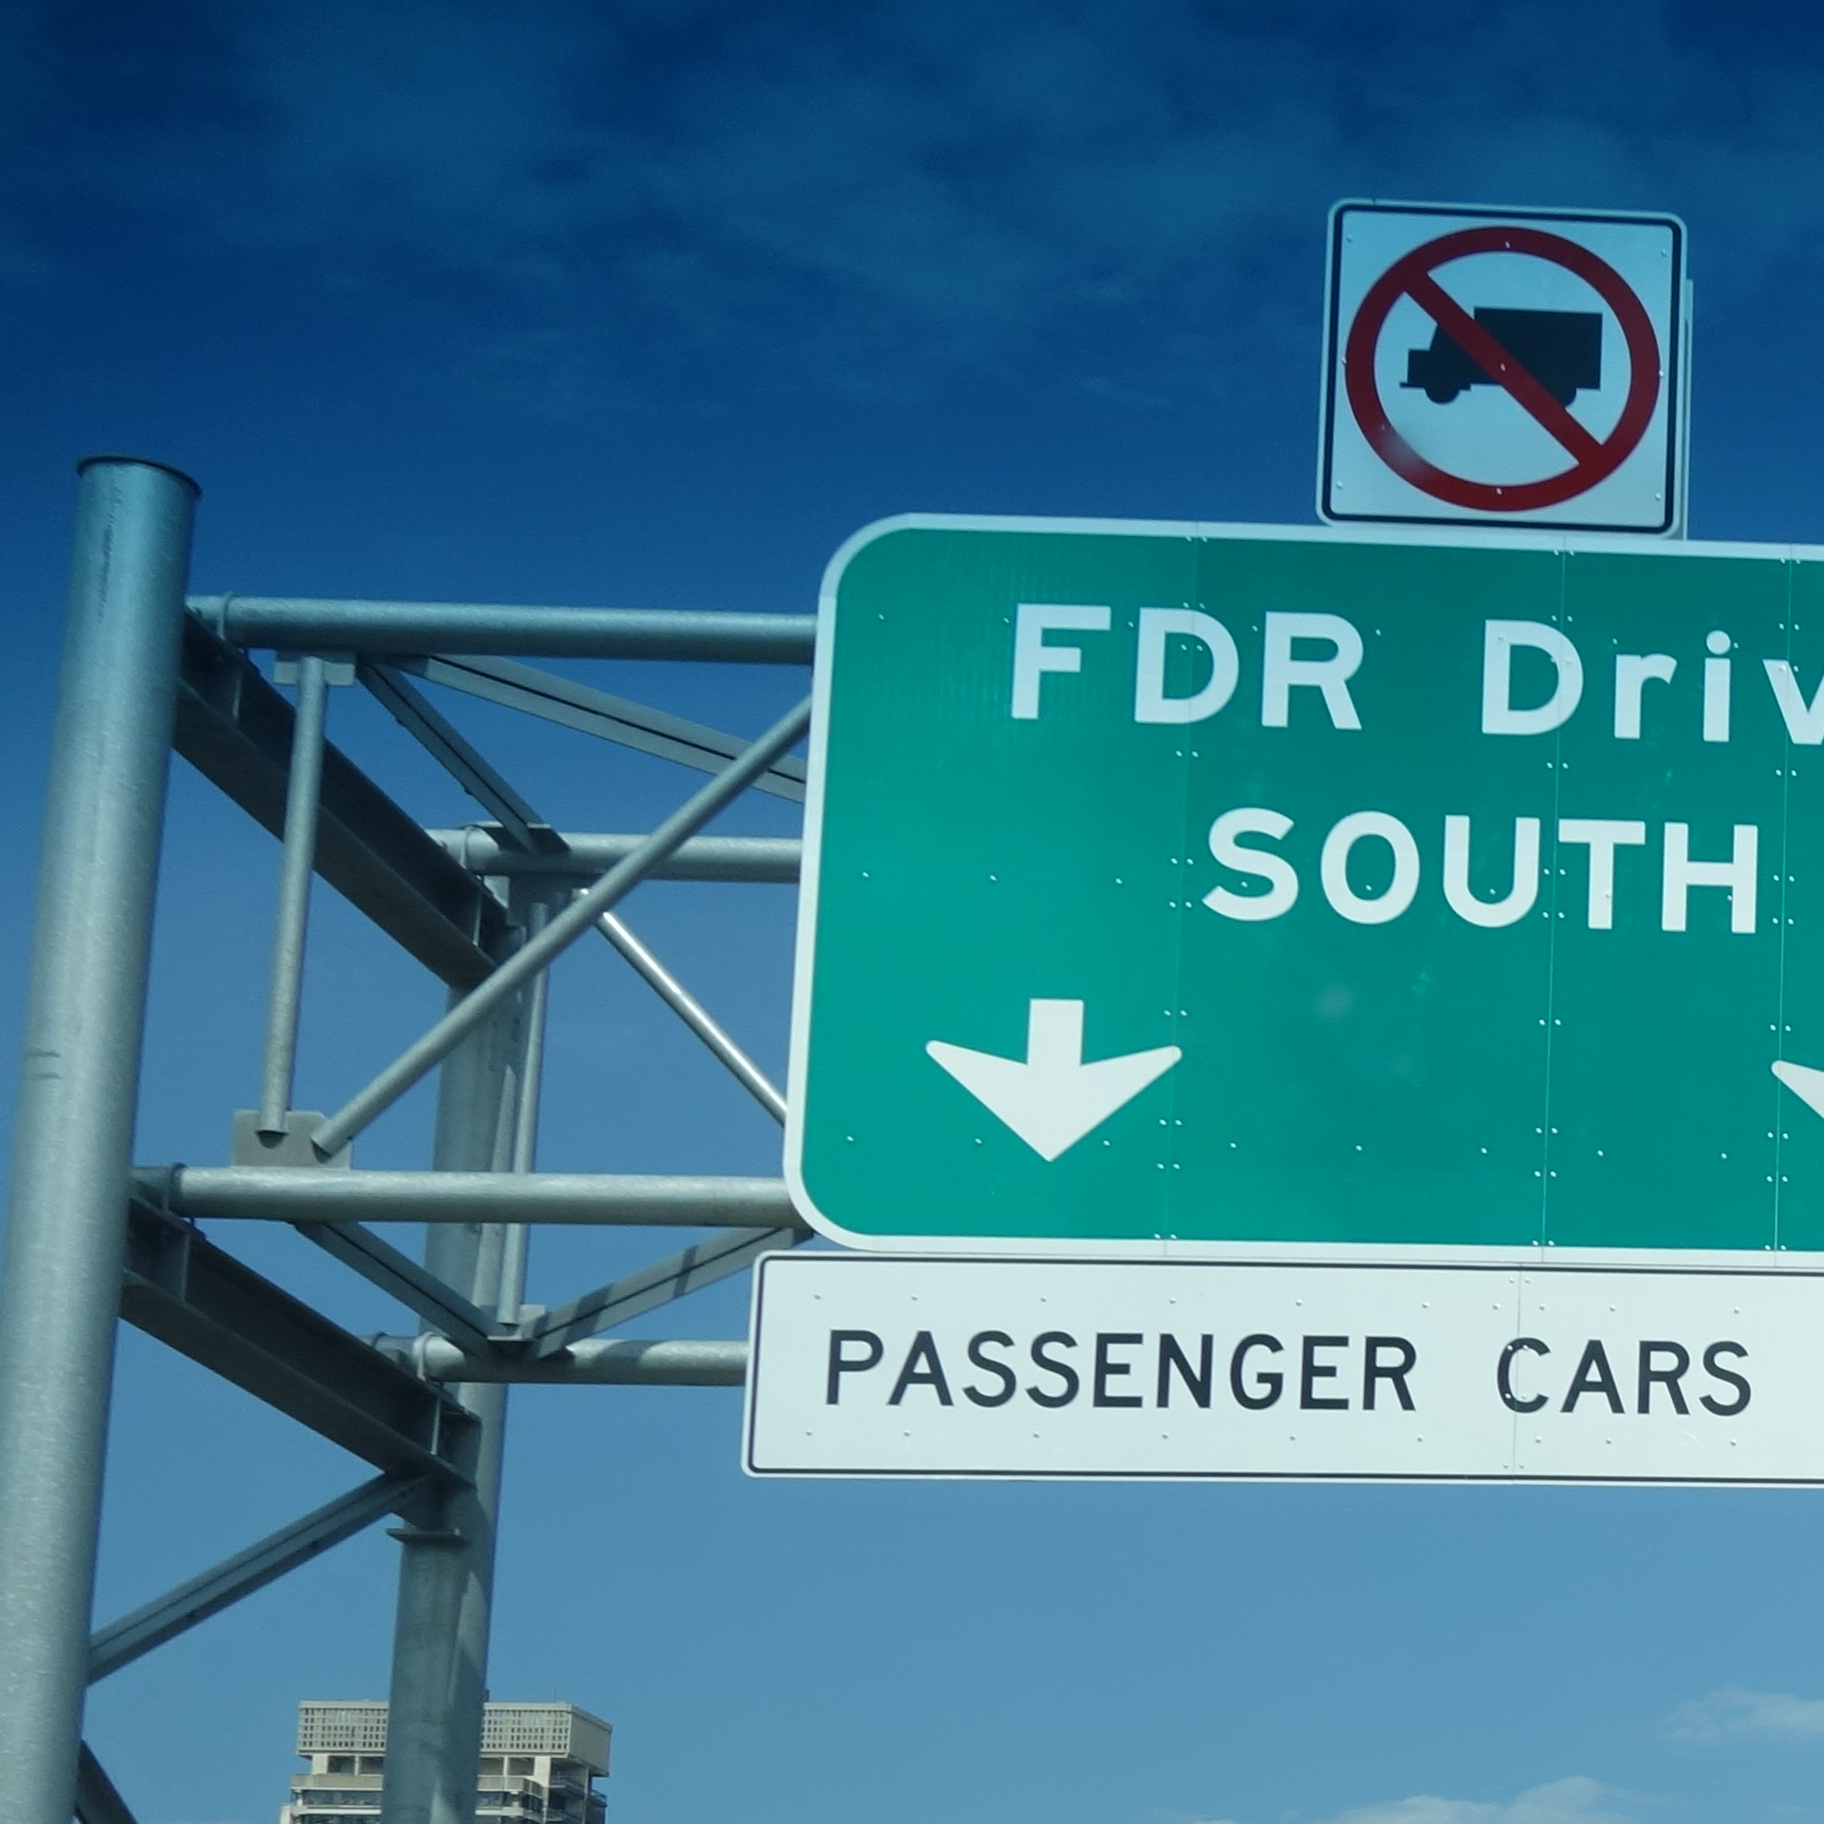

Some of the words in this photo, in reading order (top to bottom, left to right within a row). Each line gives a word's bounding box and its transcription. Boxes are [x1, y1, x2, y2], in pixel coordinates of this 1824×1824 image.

[1012, 604, 1363, 729] FDR
[1203, 808, 1758, 933] SOUTH
[827, 1330, 1416, 1410] PASSENGER
[1497, 1338, 1751, 1416] CARS
